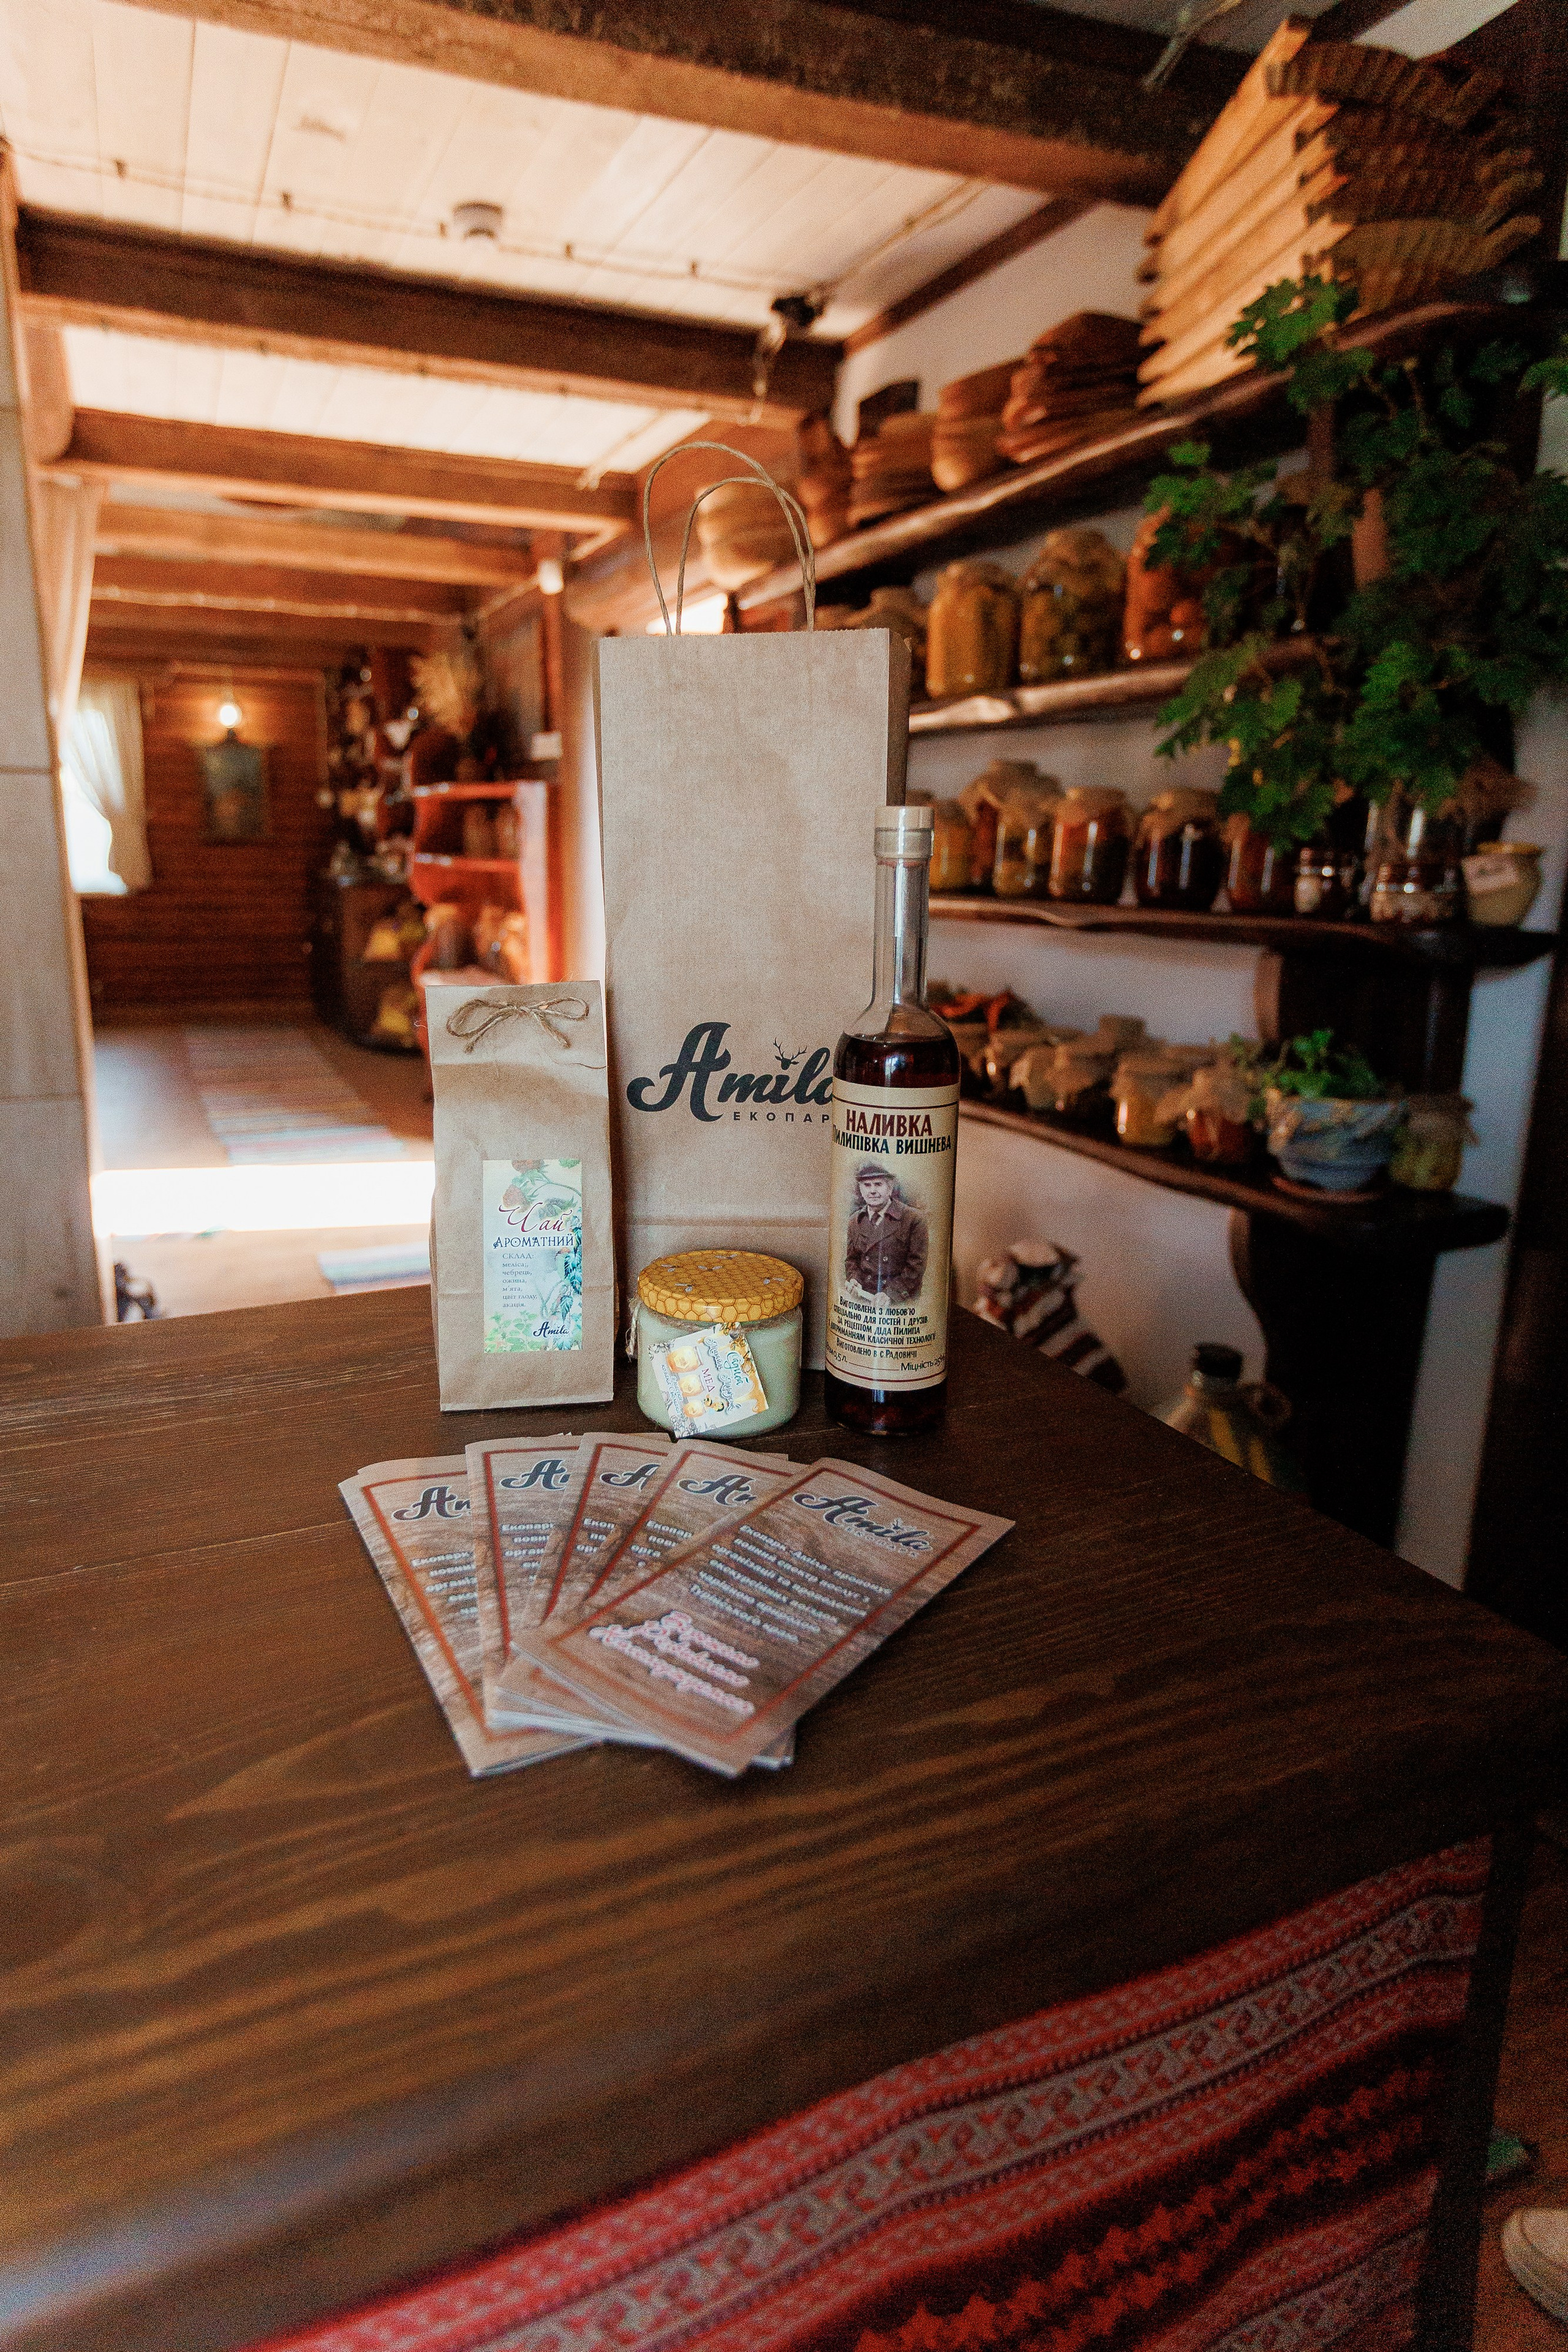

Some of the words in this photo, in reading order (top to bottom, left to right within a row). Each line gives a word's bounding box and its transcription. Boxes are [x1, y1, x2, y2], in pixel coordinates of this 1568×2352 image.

[734, 1111, 831, 1123] ЕКОПАР
[846, 1109, 932, 1137] НАЛИВКА
[832, 1124, 889, 1154] ПИЛИПІВКА
[896, 1135, 951, 1154] ВИШНЕВА
[499, 1202, 573, 1232] Чай
[493, 1234, 574, 1250] АРОМАТНИЙ
[864, 1316, 876, 1324] ДЛЯ
[879, 1316, 901, 1325] ГОСТЕЙ
[533, 1321, 570, 1338] Amila
[875, 1327, 891, 1336] ДІДА
[901, 1360, 933, 1371] Міцність
[702, 1368, 715, 1392] МЕД
[583, 1518, 615, 1529] Екоп
[646, 1520, 693, 1539] Екопар
[794, 1494, 932, 1550] Amila
